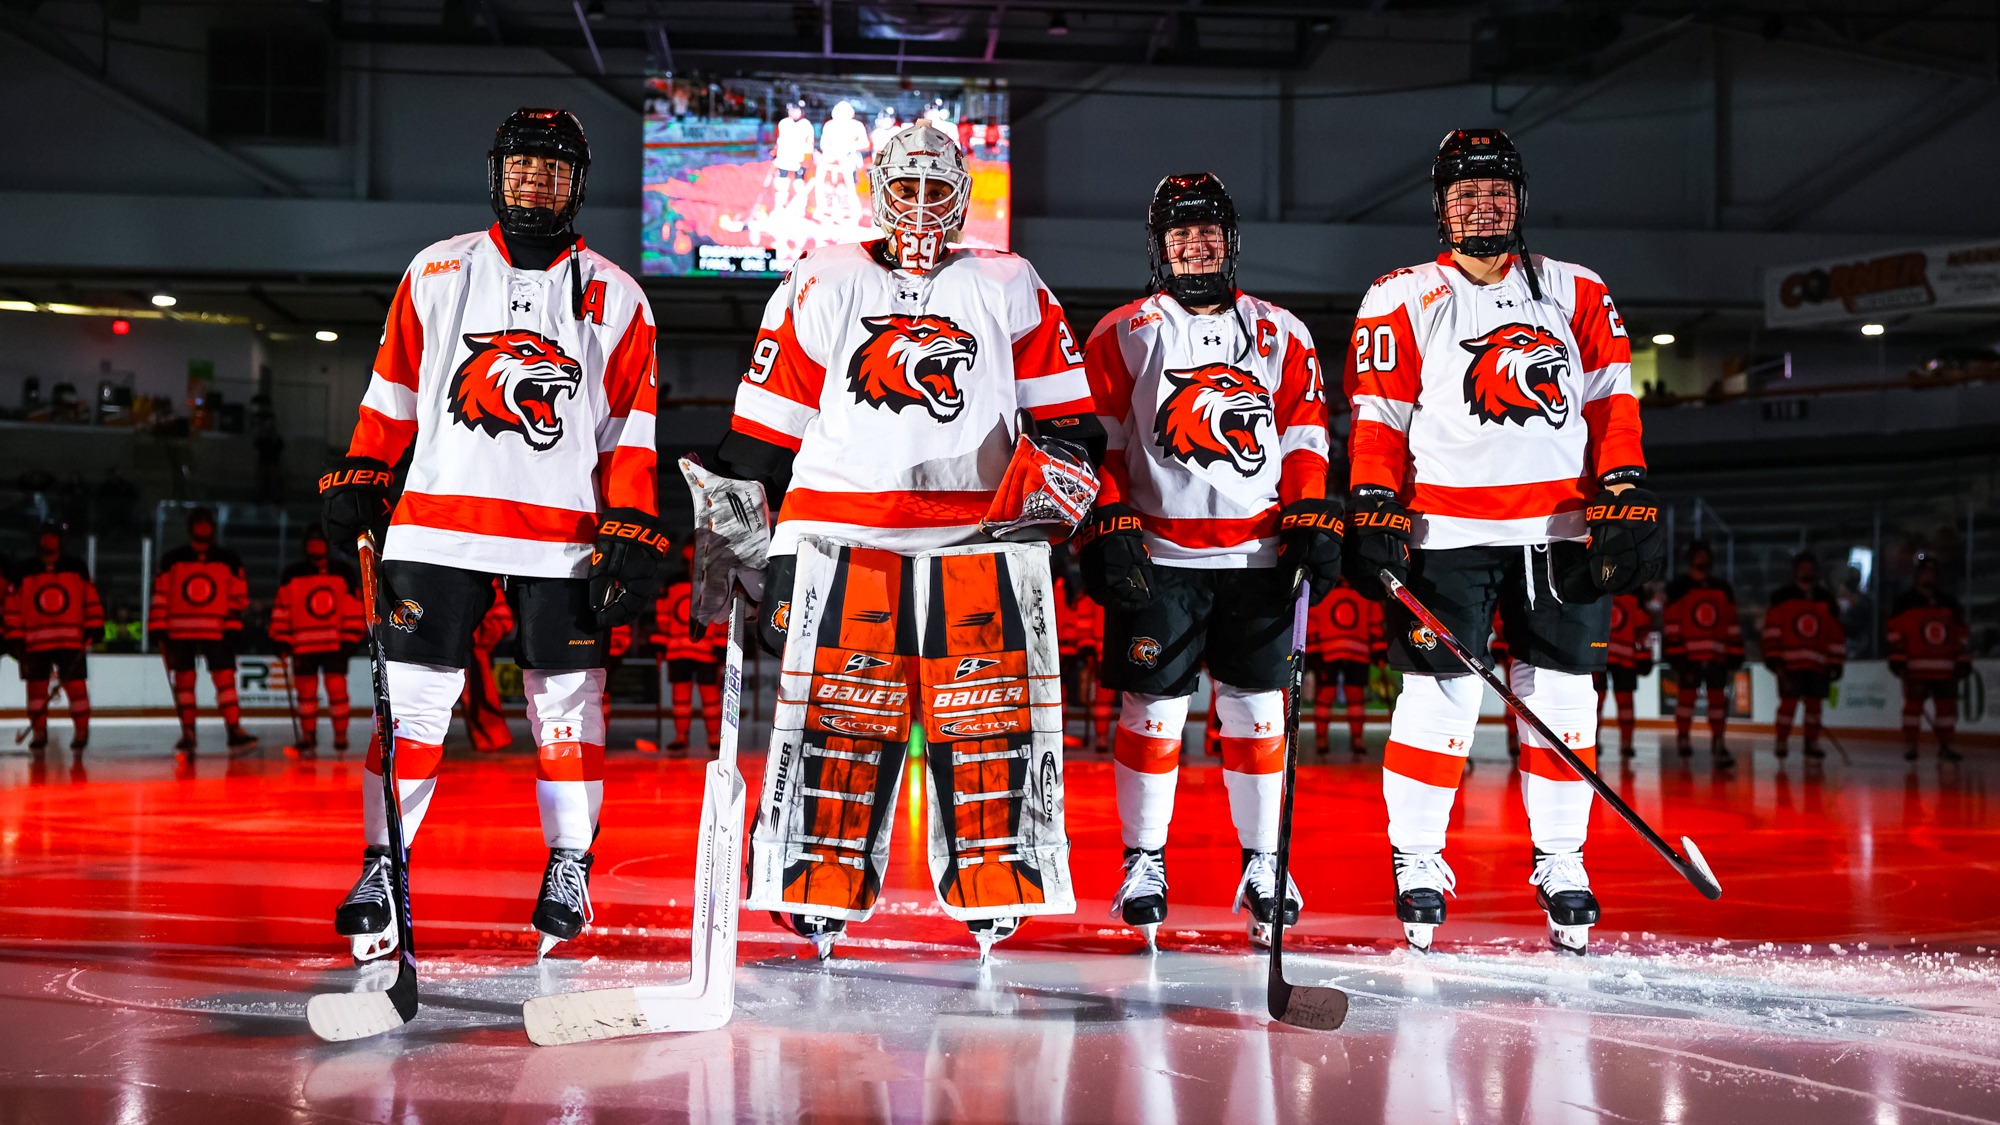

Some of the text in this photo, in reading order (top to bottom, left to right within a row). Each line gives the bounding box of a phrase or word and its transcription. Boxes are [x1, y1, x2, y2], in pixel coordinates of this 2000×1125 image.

[1471, 137, 1490, 145] 20
[901, 233, 937, 270] 29
[422, 260, 461, 277] AHA
[575, 280, 607, 325] A
[1422, 285, 1452, 311] AHA
[1129, 312, 1163, 331] AHA
[1256, 318, 1278, 358] C
[1355, 324, 1397, 374] 20
[746, 337, 780, 385] 9
[1281, 513, 1344, 537] BAUE
[1585, 505, 1658, 522] BAUER
[802, 589, 811, 636] FLEXX
[726, 663, 742, 731] BAUER
[816, 683, 908, 706] BAUER
[932, 686, 1024, 708] BAUER
[820, 715, 898, 735] REACTOR
[940, 719, 1019, 735] REACTOR
[773, 742, 792, 803] BAUER
[1045, 752, 1053, 822] REACTOR
